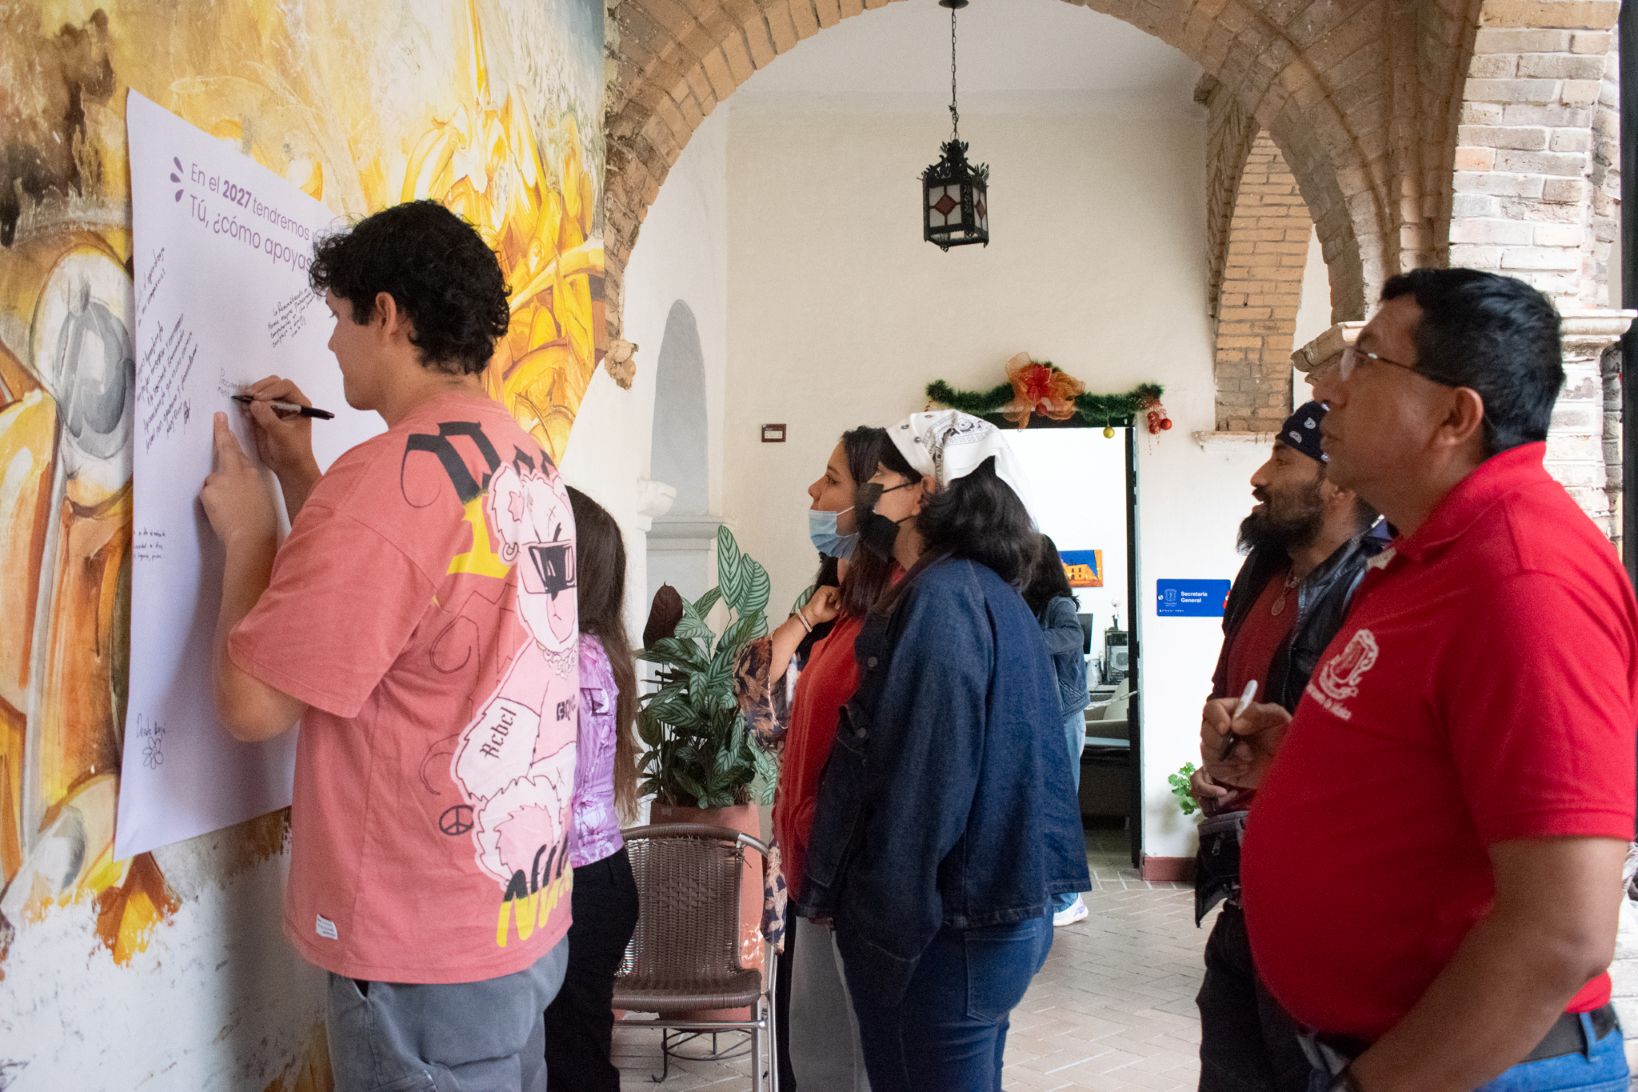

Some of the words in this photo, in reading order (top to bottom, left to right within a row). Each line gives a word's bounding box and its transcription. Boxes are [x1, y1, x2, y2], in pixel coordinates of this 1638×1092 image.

[190, 194, 209, 228] Tú,
[212, 213, 261, 249] ¿cómo
[191, 162, 206, 186] En
[208, 175, 220, 193] el
[222, 179, 252, 208] 2027
[252, 197, 310, 240] tendremos
